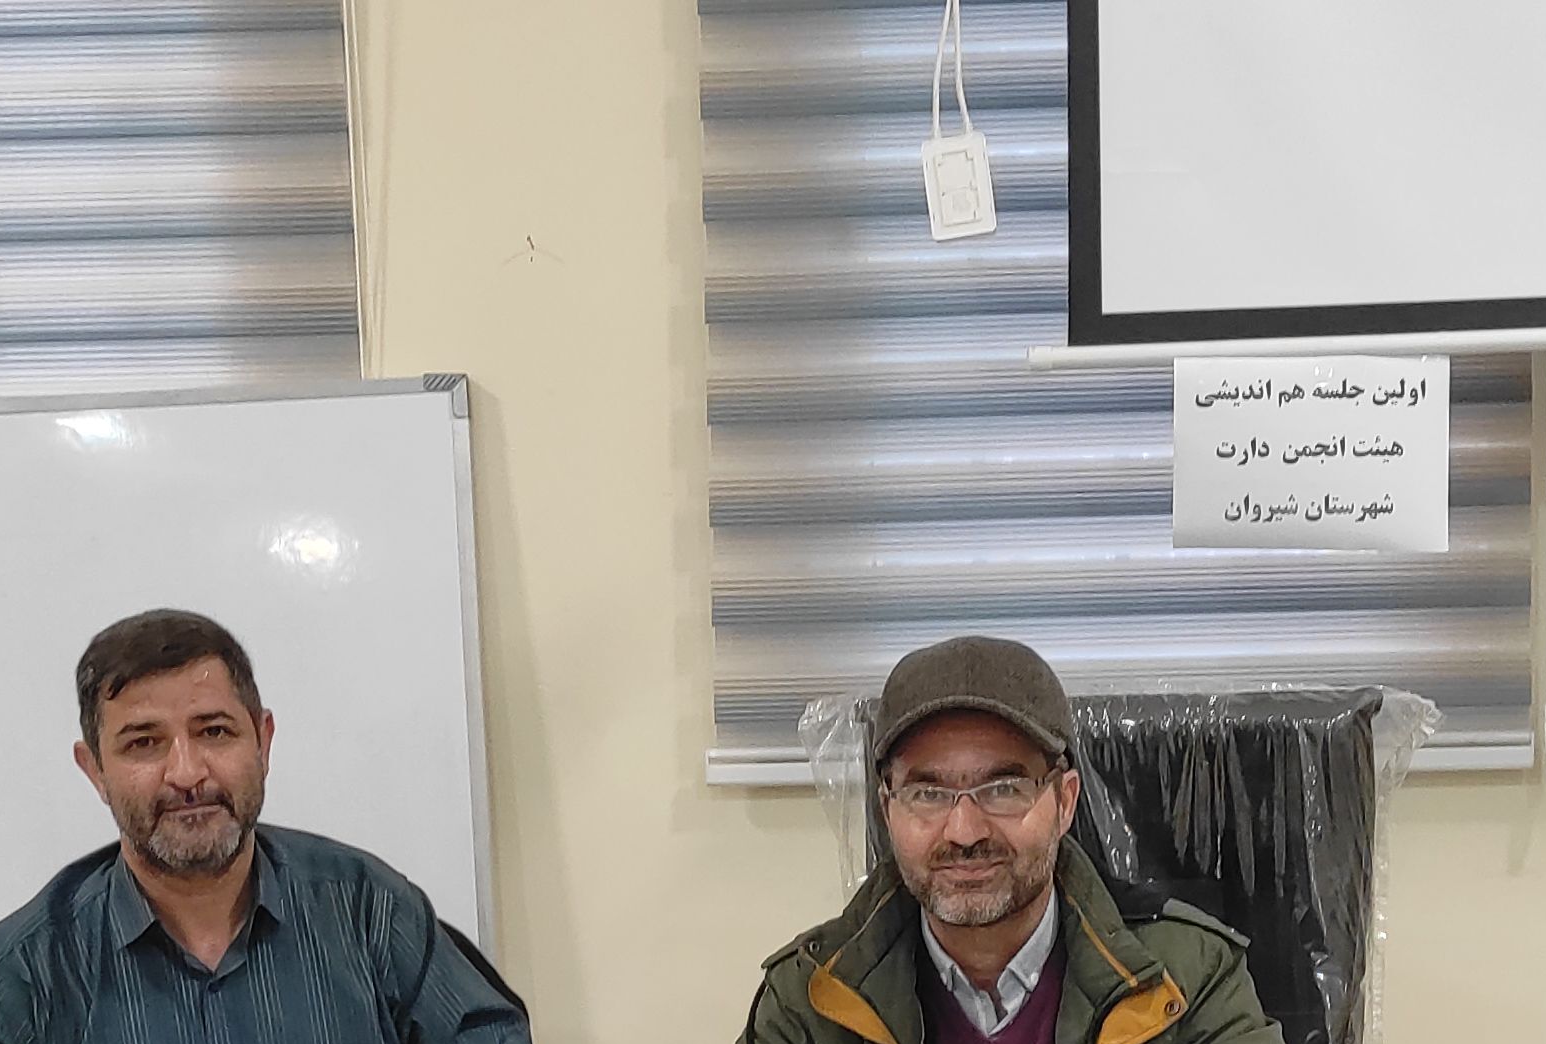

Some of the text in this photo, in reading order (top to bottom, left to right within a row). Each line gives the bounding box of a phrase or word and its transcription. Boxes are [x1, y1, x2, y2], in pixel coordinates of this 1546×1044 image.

[1194, 377, 1427, 408] اولین جلسه هم اندیشی
[1216, 435, 1404, 467] هیئت انجمن دارت
[1224, 492, 1394, 523] شهرستان شیروان
